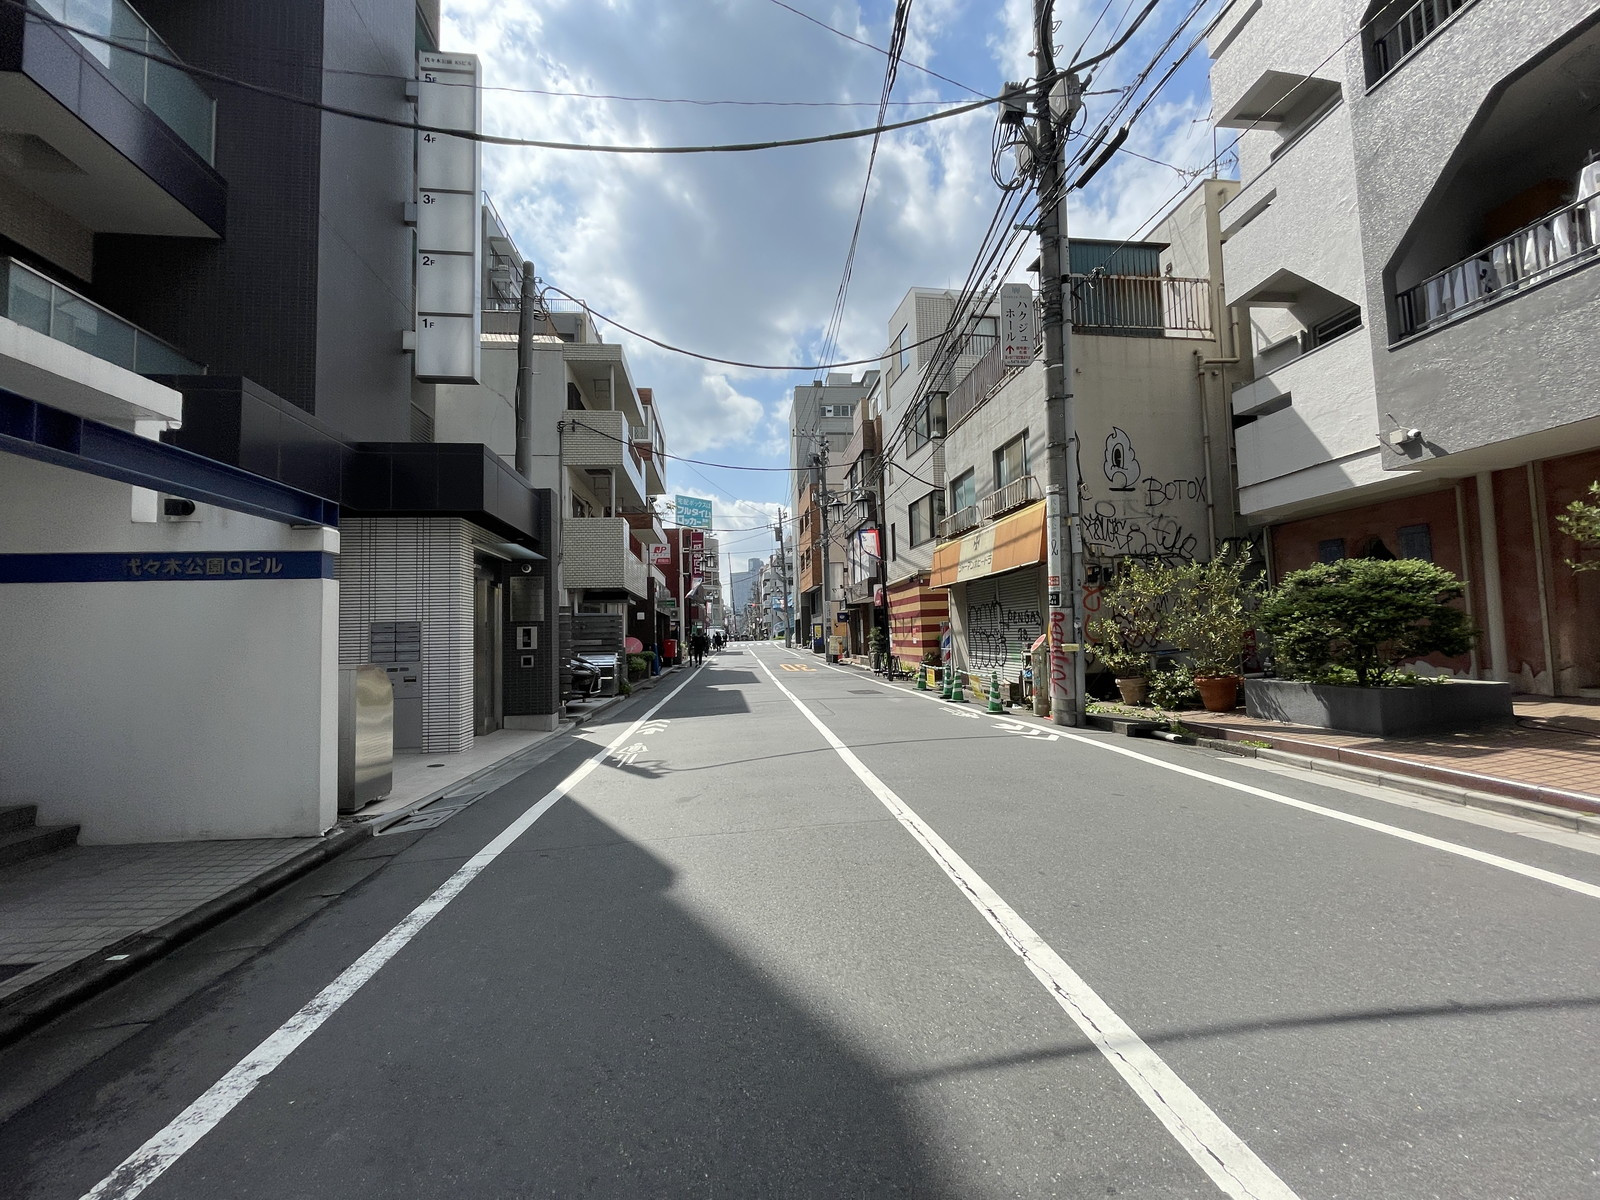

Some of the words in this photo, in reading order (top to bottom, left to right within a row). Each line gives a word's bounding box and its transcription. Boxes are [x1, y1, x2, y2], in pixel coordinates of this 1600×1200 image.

[424, 73, 437, 83] 5F
[423, 133, 437, 144] 4F
[423, 194, 436, 205] 3F
[422, 255, 436, 266] 2F
[422, 318, 435, 328] 1F
[1005, 308, 1016, 342] ホール
[1017, 301, 1028, 342] ハクジュ
[1142, 476, 1206, 507] BOTOX
[677, 506, 711, 519] フルタイム
[677, 515, 702, 526] ロッカー
[125, 556, 283, 576] 代々木公園Qビル
